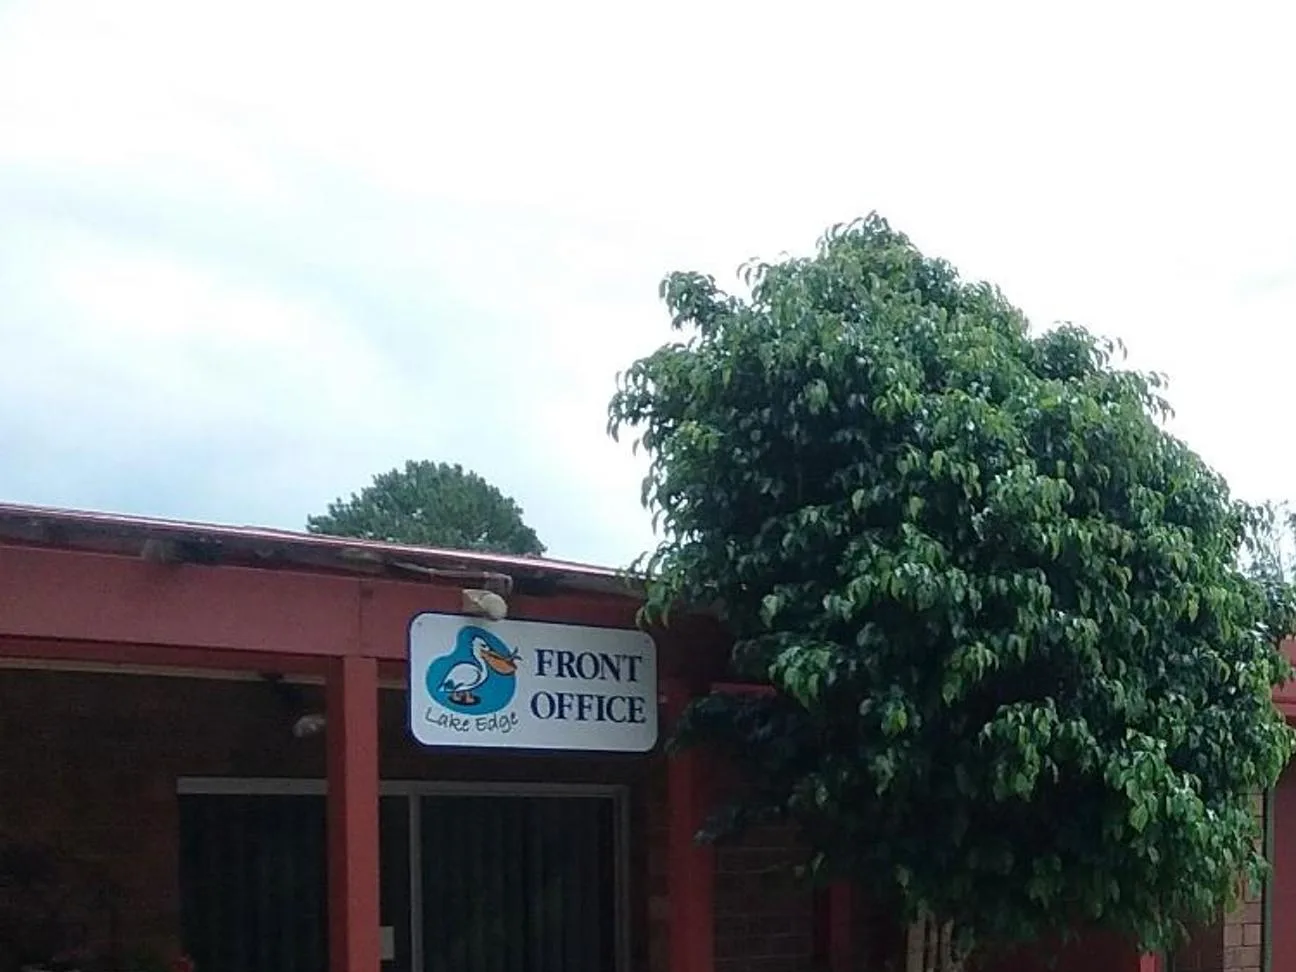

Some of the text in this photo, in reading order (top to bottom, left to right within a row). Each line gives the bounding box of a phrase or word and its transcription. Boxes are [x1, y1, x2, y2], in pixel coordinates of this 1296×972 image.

[535, 648, 642, 682] FRONT
[425, 707, 519, 733] Lake Edge
[530, 691, 647, 724] OFFICE
